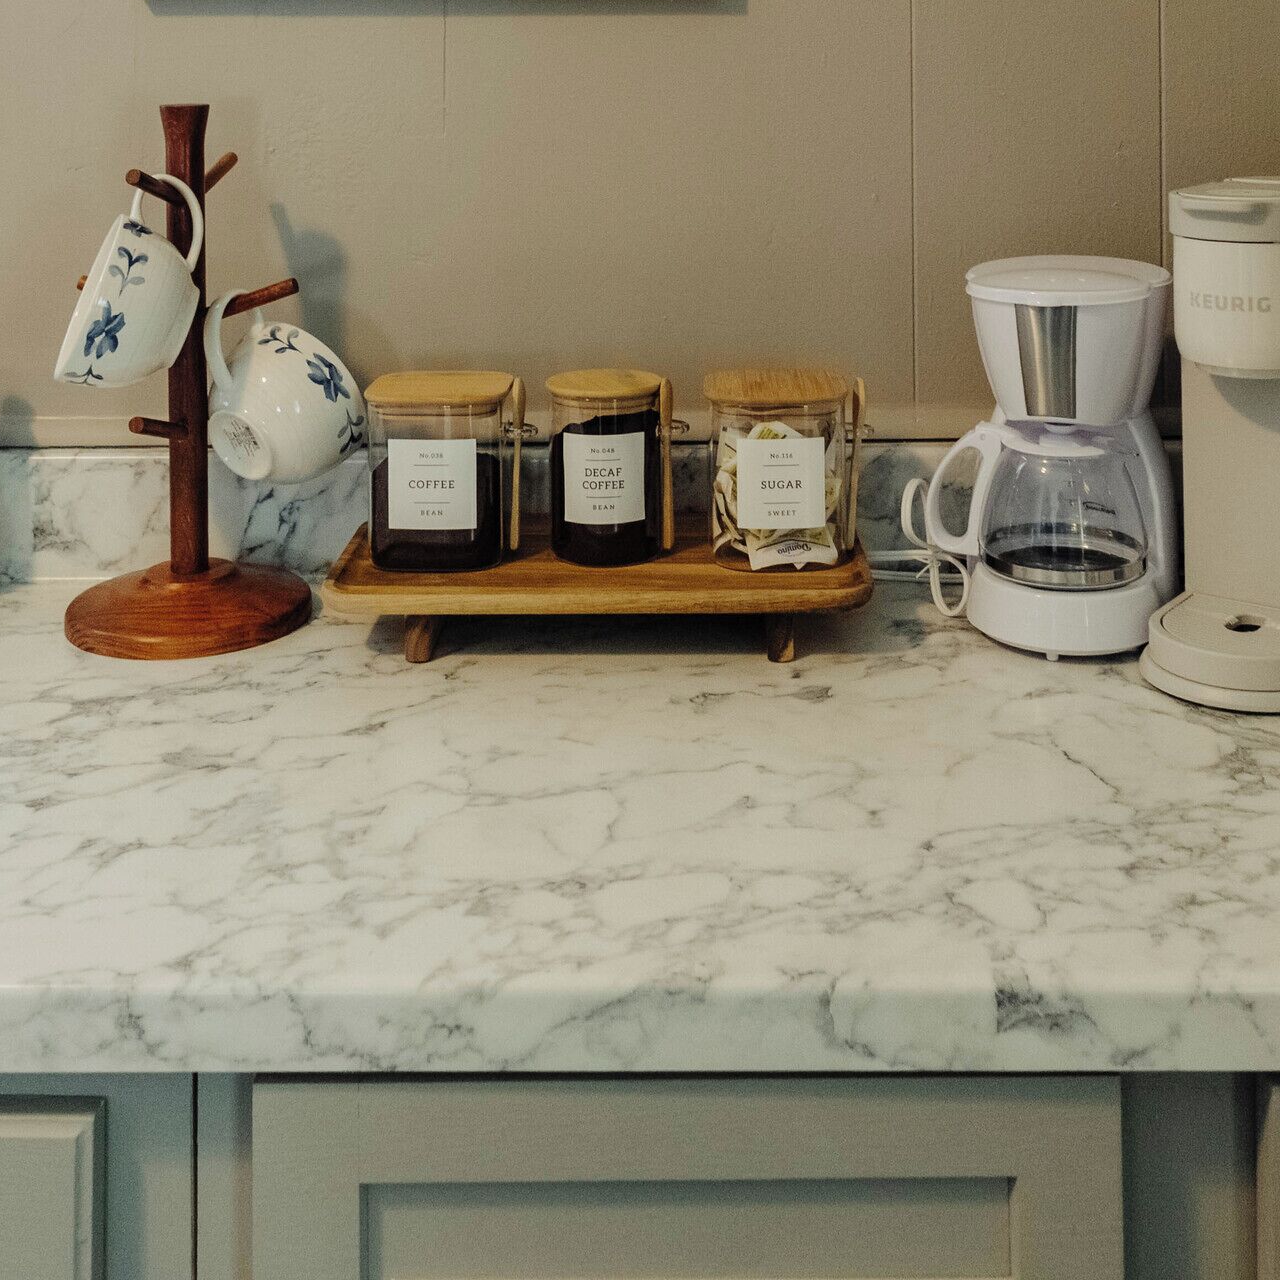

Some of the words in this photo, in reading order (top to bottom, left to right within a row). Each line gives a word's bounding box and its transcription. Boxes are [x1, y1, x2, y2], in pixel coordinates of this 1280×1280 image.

[1190, 291, 1272, 313] KEURIG
[585, 467, 622, 477] DECAF
[409, 480, 455, 489] COFFEE
[582, 480, 625, 490] COFFEE
[761, 480, 803, 490] SUGAR
[777, 543, 812, 555] Domino
